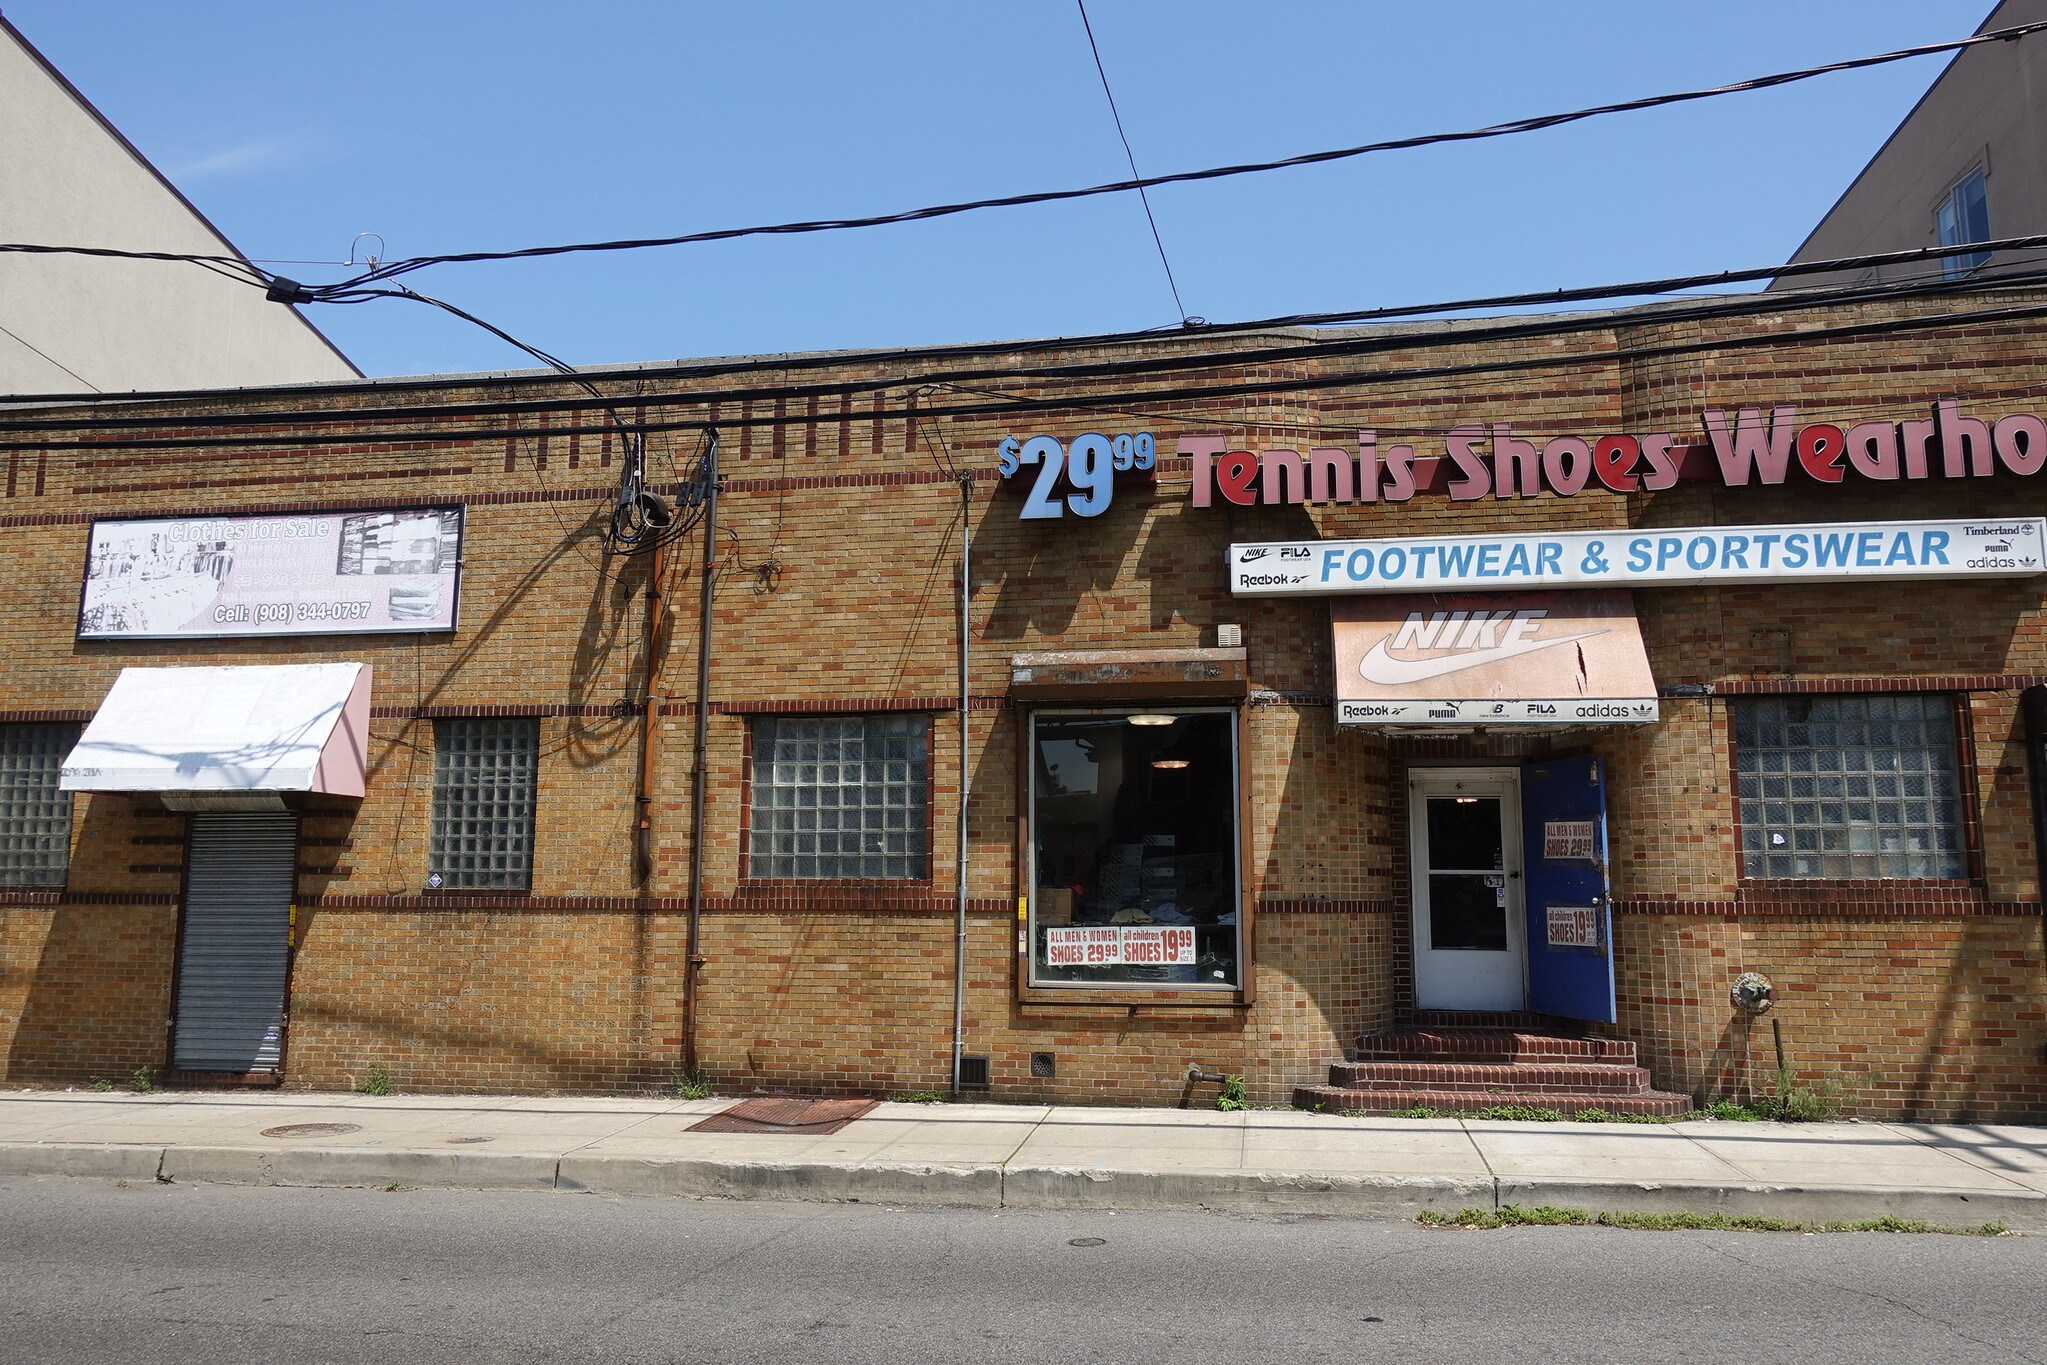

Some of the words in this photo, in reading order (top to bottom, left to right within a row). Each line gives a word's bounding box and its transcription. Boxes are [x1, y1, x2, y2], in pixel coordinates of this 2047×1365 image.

[1177, 429, 1416, 507] Tennis
[1446, 422, 1678, 500] Shoes
[169, 520, 246, 542] Clothes
[250, 518, 281, 539] for
[284, 517, 330, 538] Sale
[1963, 526, 2019, 536] Timberland
[1244, 547, 1269, 557] NIKE
[1281, 547, 1311, 558] FILA
[1321, 541, 1562, 582] FOOTWEAR
[1580, 540, 1610, 574] &
[1626, 530, 1950, 572] SPORTSWEAR
[1966, 557, 2016, 568] adidas
[1240, 573, 1288, 588] Reebok
[214, 605, 249, 623] Cell:
[253, 603, 293, 625] (908)
[297, 602, 370, 620] 344-0797
[1389, 609, 1549, 650] NIKE
[1343, 705, 1389, 719] Reebok
[1428, 709, 1456, 718] PUMA
[1527, 704, 1557, 714] FILA
[1575, 704, 1629, 718] adidas
[1547, 825, 1556, 836] ALL
[1557, 825, 1568, 836] MEN
[1572, 825, 1591, 836] WOMEN
[1547, 839, 1569, 856] SHOES
[1051, 931, 1063, 942] ALL
[1065, 931, 1080, 942] MEN
[1083, 931, 1087, 942] &
[1089, 930, 1117, 942] WOMEN
[1133, 930, 1159, 940] children
[1550, 923, 1574, 942] SHOES
[1051, 945, 1083, 962] SHOES
[1124, 942, 1160, 961] SHOES
